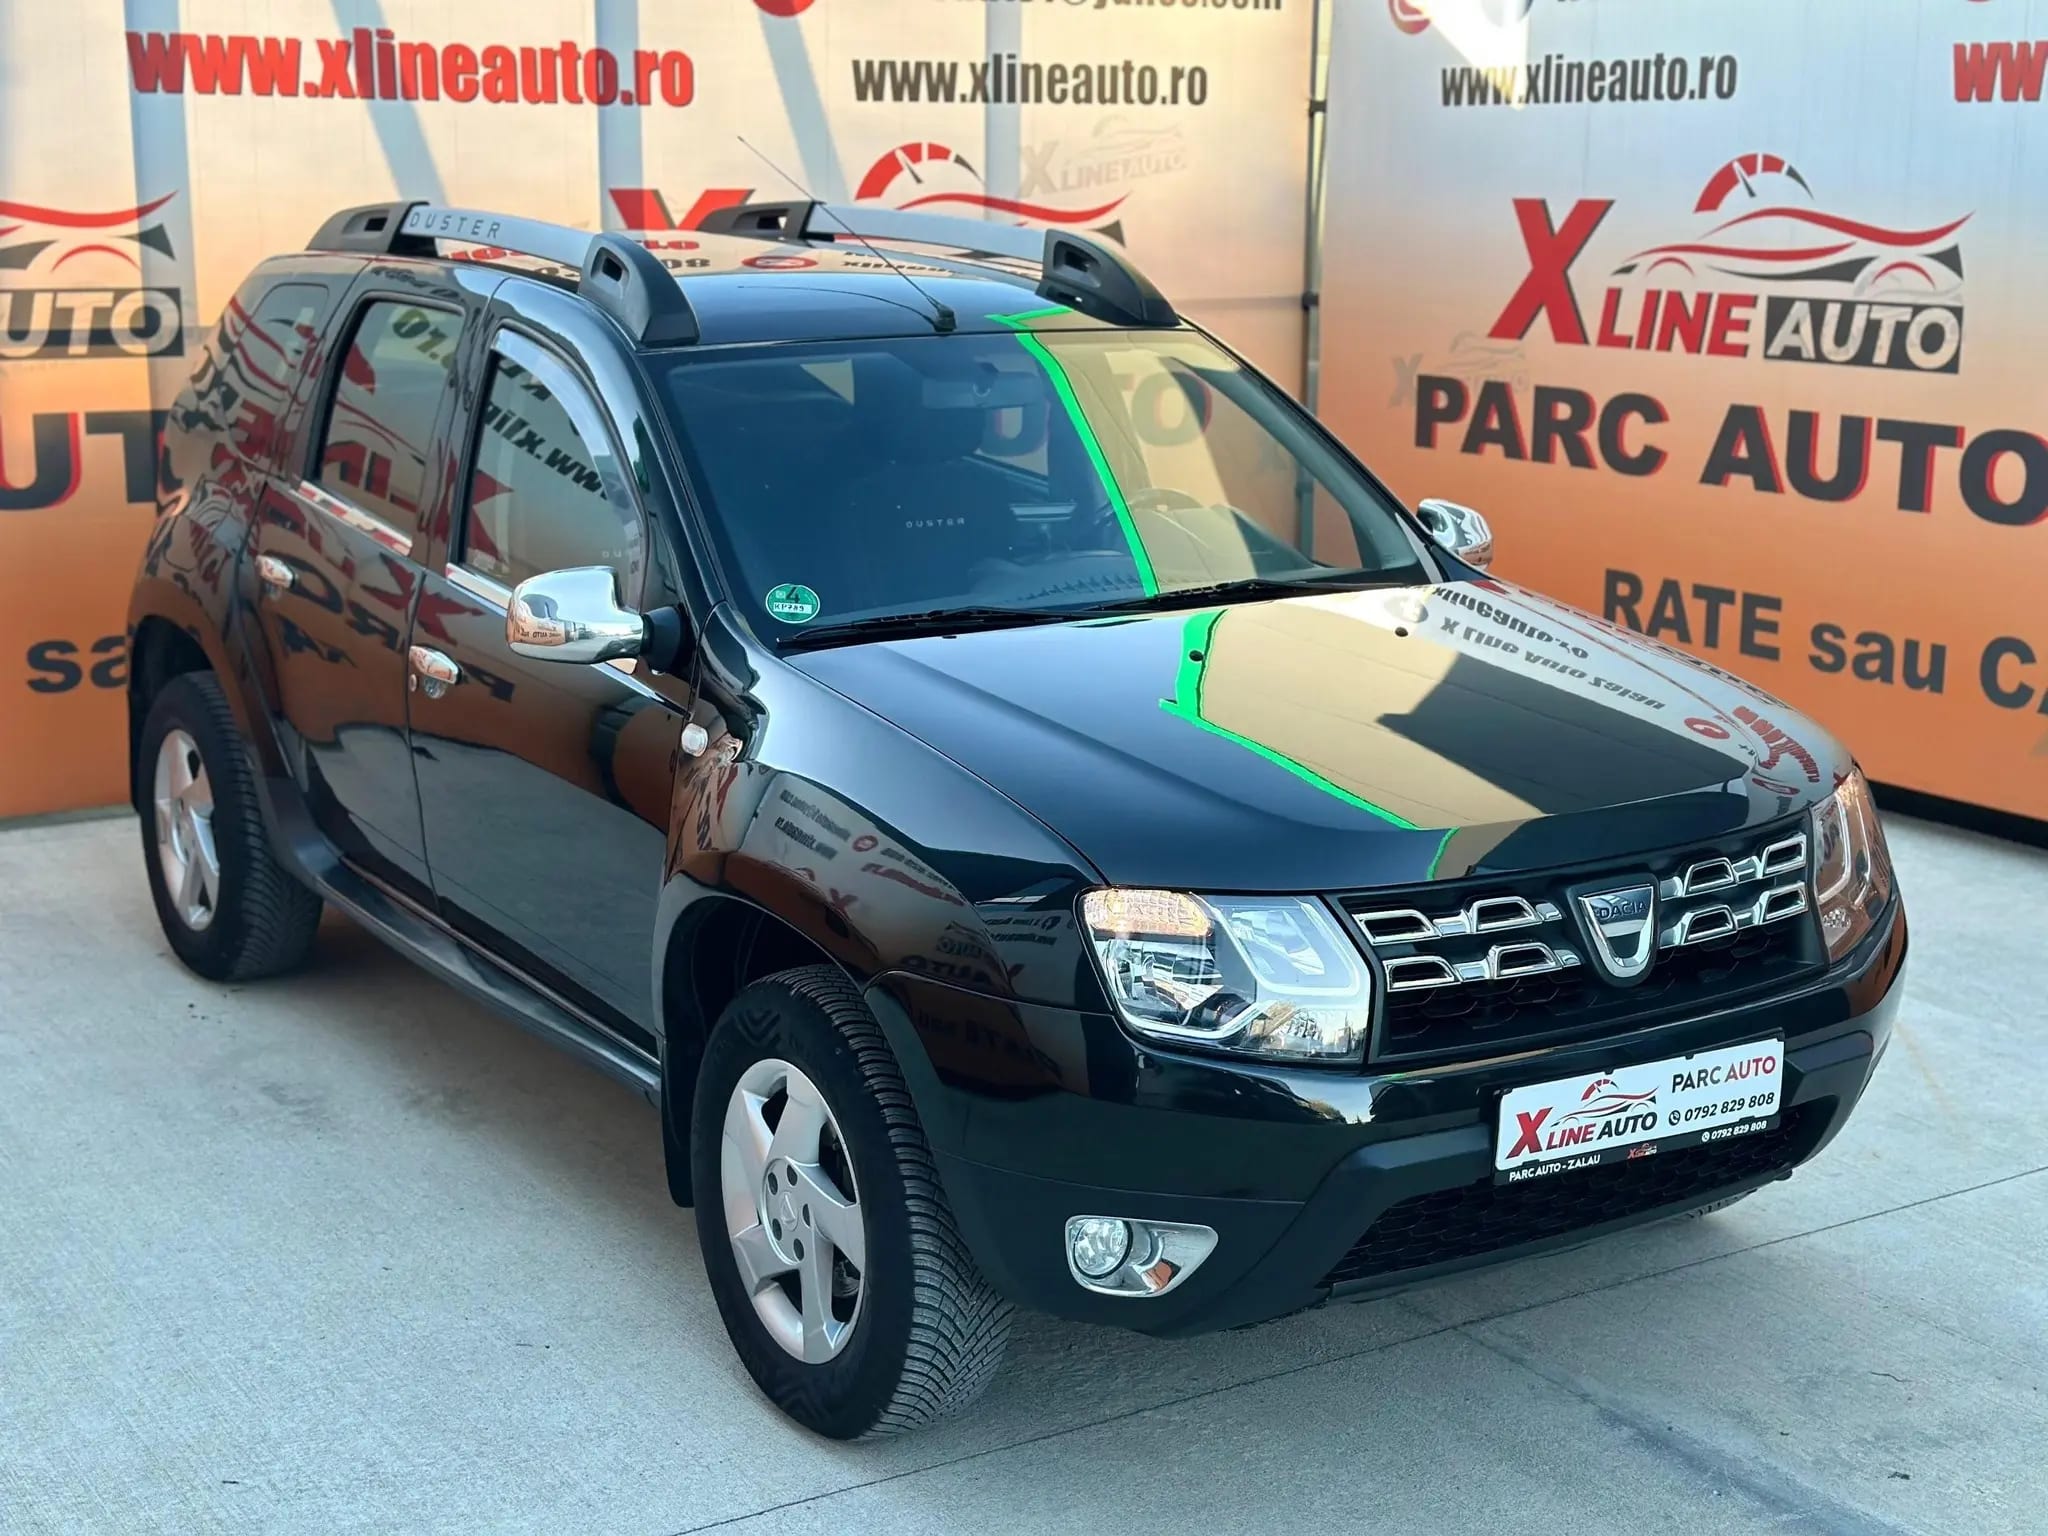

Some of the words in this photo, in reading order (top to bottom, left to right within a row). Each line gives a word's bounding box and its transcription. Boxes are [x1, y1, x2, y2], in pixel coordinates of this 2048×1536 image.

[126, 28, 693, 107] www.xlineauto.ro
[851, 53, 1208, 105] www.xlineauto.ro
[1441, 53, 1737, 107] www.xlineauto.ro
[409, 211, 501, 239] DUSTER
[1766, 299, 1960, 370] AUTO
[1414, 375, 1669, 476] PARC
[1699, 403, 2048, 527] AUTO
[1604, 569, 1782, 662] RATE
[1808, 622, 1947, 694] sau
[1599, 900, 1649, 920] DACIA
[1671, 1065, 1722, 1094] PARC
[1723, 1055, 1777, 1083] AUTO
[1596, 1111, 1658, 1140] AUTO
[1684, 1102, 1718, 1123] 0792
[1720, 1096, 1745, 1115] 829
[1748, 1092, 1775, 1110] 808
[1710, 1126, 1735, 1140] 0792
[1735, 1123, 1750, 1136] 829
[1750, 1120, 1767, 1132] 808
[1508, 1165, 1534, 1183] PARC
[1534, 1161, 1562, 1179] AUTO
[1567, 1154, 1601, 1172] ZALAU
